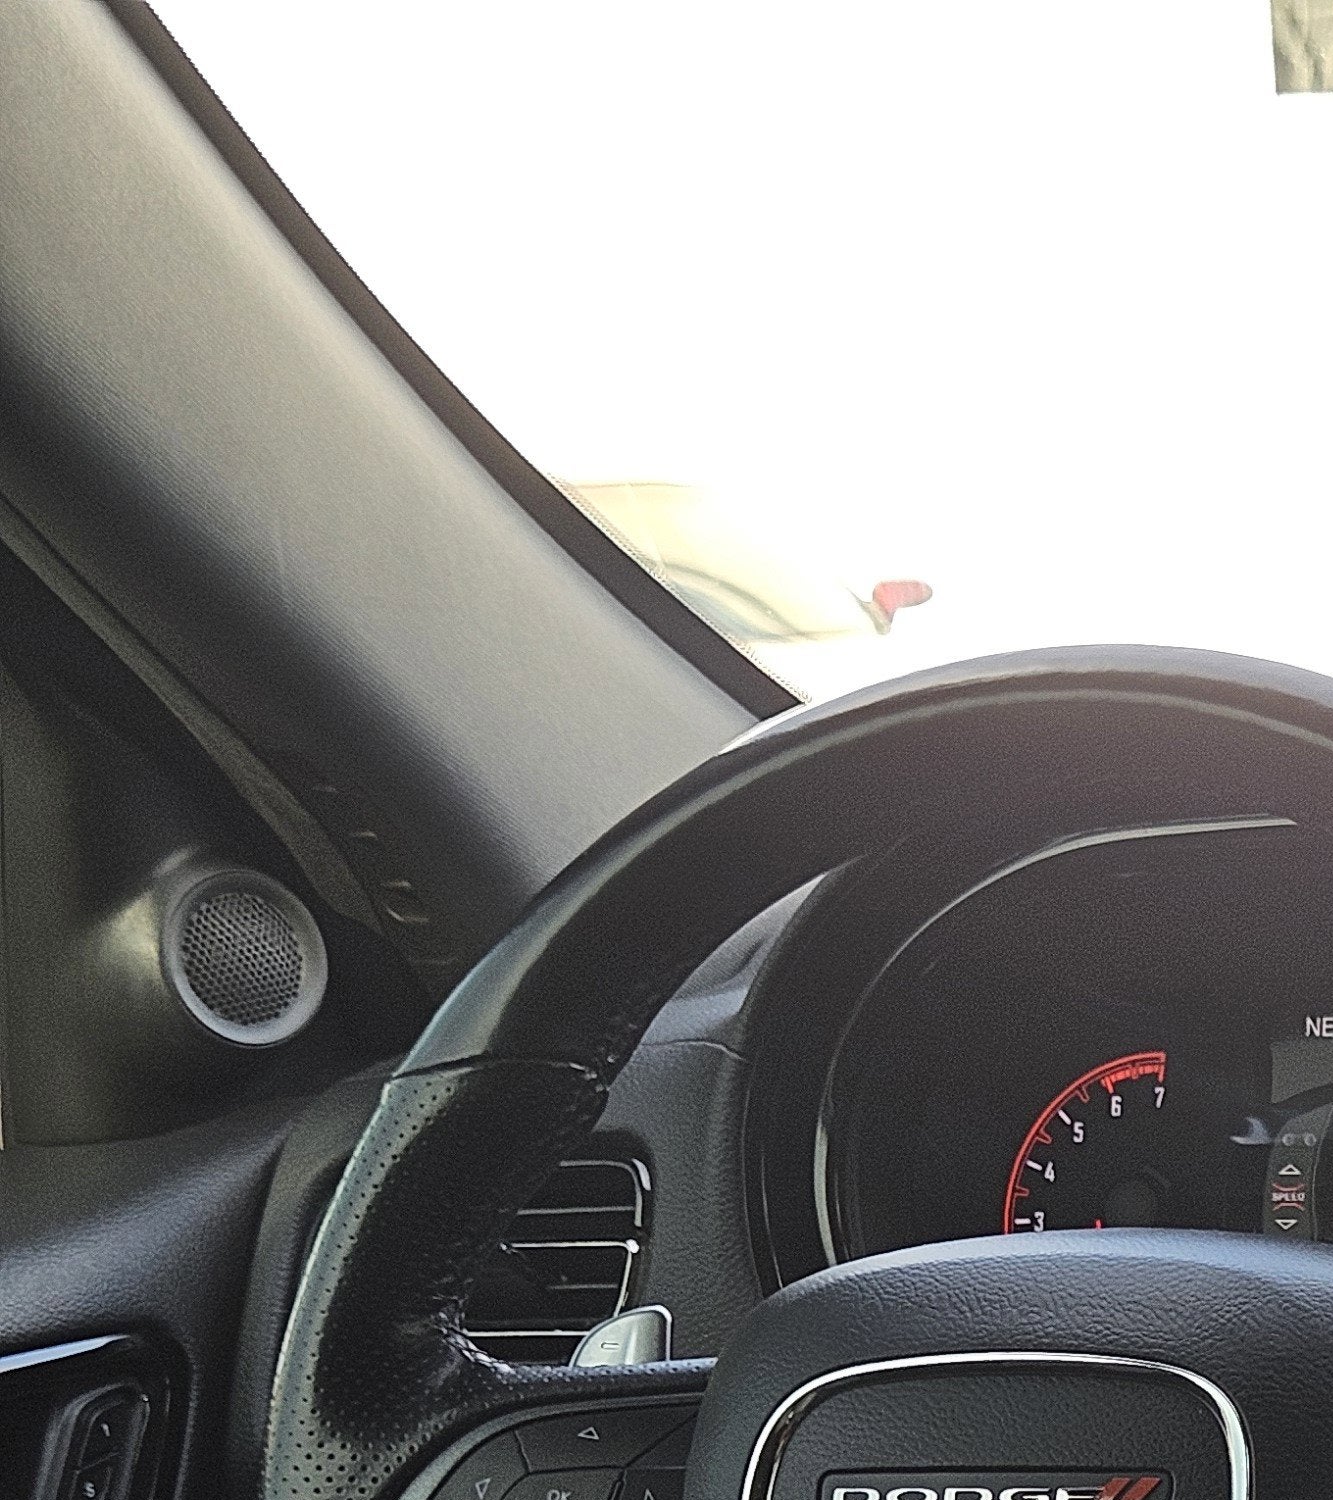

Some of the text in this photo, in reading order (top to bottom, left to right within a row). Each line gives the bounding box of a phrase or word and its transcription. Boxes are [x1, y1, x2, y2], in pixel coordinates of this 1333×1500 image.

[1111, 1095, 1122, 1117] 6
[1155, 1087, 1164, 1108] 7
[1073, 1122, 1084, 1143] 5
[1044, 1161, 1055, 1182] 4
[1034, 1211, 1044, 1232] 3
